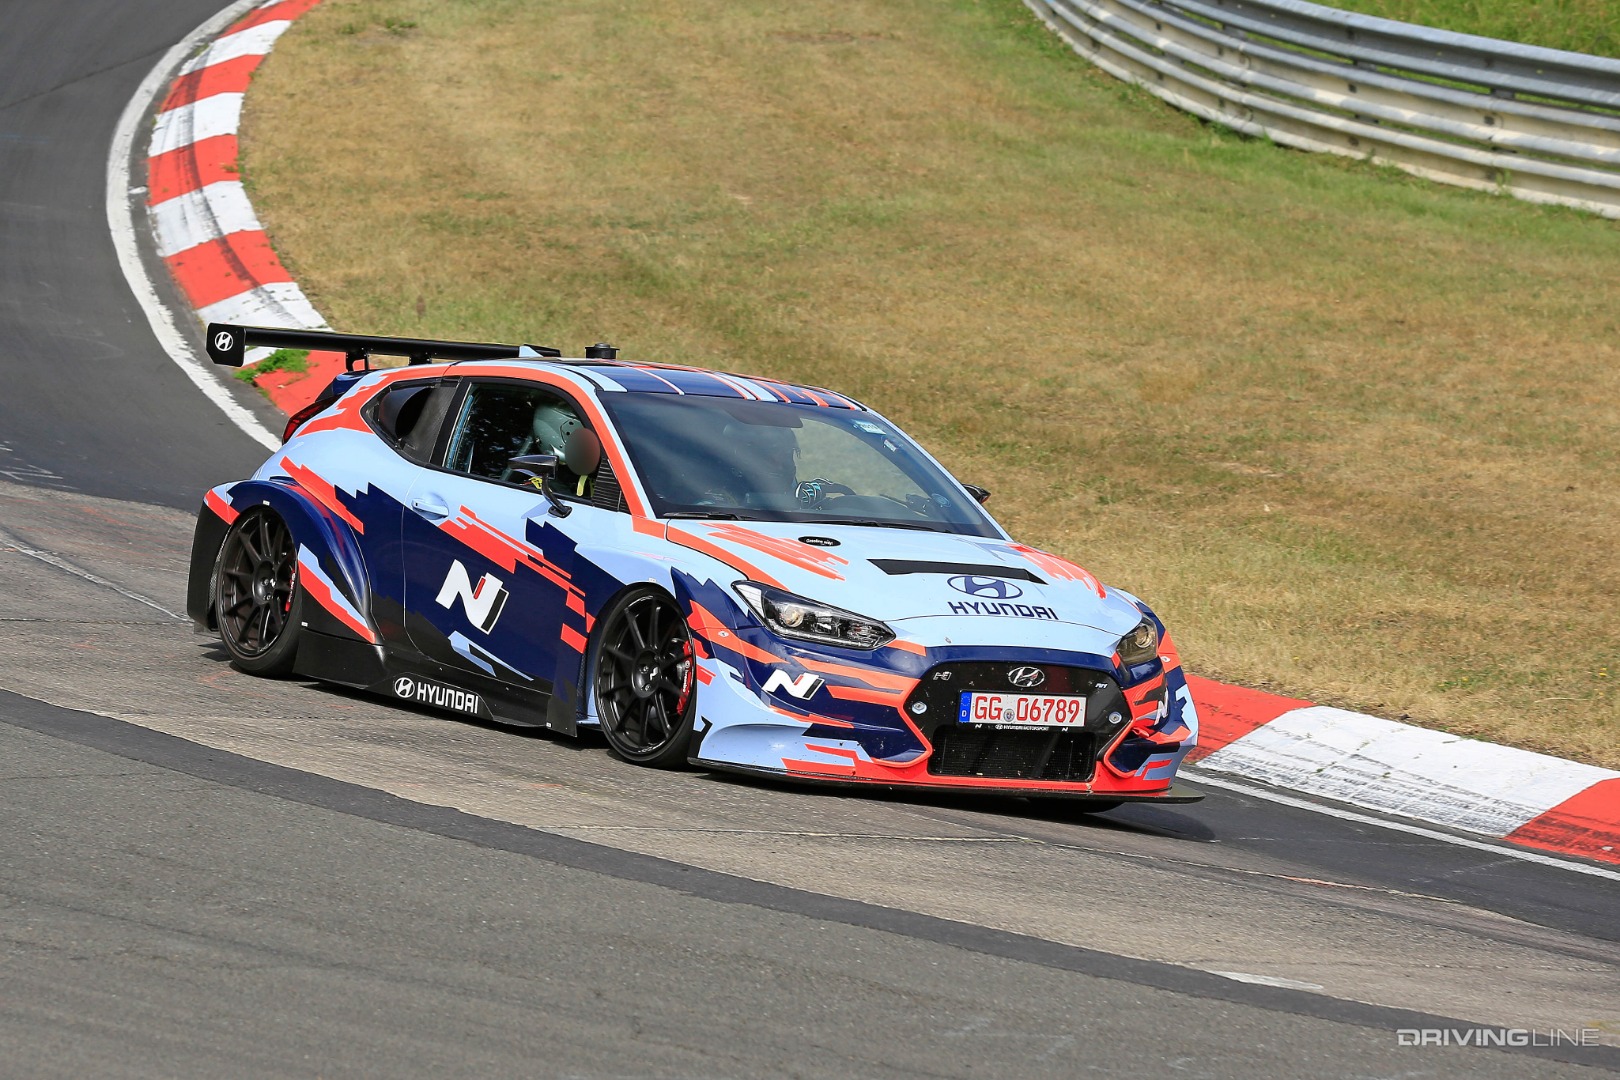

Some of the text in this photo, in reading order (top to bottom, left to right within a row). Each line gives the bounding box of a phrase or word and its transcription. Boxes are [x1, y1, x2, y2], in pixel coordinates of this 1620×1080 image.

[435, 559, 509, 635] N
[947, 601, 1059, 620] HYUNDAI
[416, 681, 479, 714] HYUNDAI
[762, 669, 825, 700] N
[974, 696, 1080, 723] GG 06789
